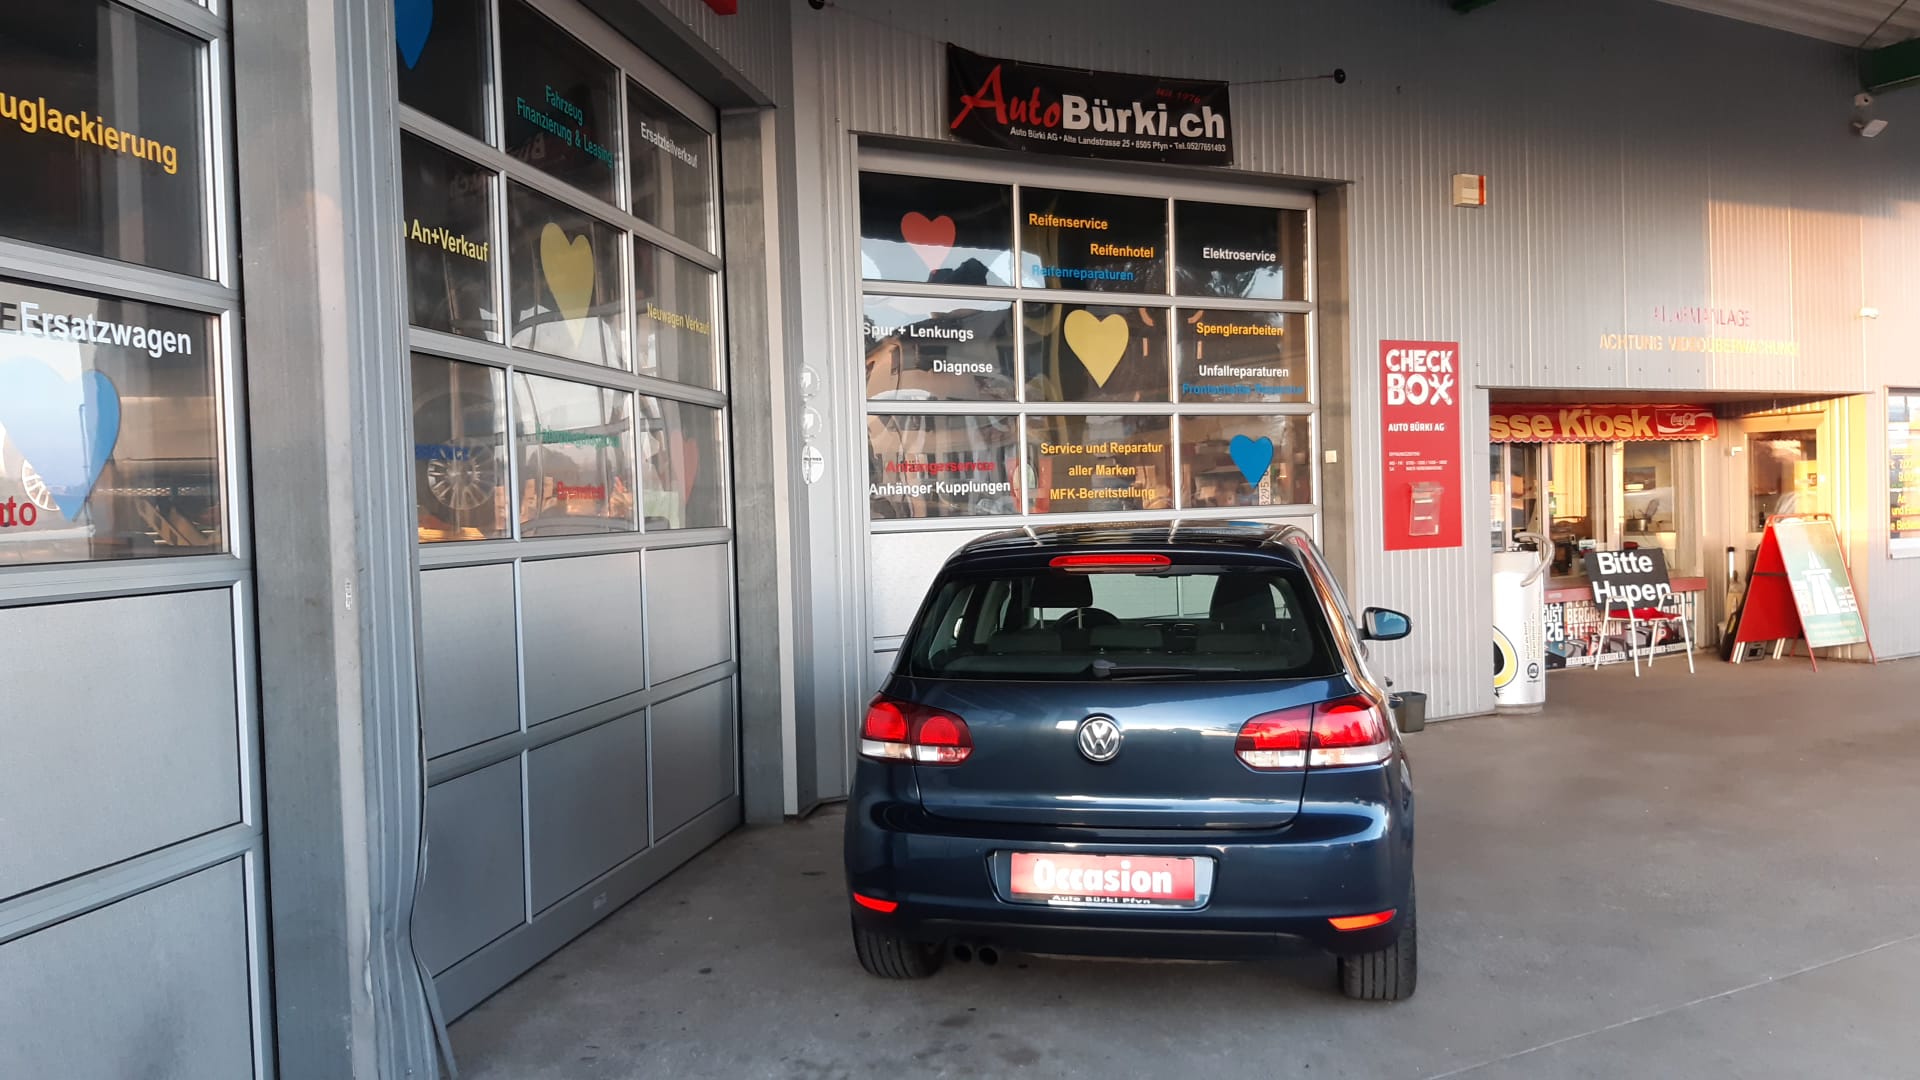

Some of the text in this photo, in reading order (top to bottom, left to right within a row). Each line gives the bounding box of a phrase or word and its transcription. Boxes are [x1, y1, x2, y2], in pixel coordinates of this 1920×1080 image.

[545, 85, 584, 126] Fahrzeug
[516, 96, 573, 146] Finanzierung
[574, 130, 581, 148] &
[583, 134, 615, 169] Leasing
[1010, 126, 1027, 137] Auto
[1028, 129, 1046, 140] Bürki
[1047, 132, 1058, 141] AG
[1078, 136, 1121, 148] Landstrasse
[1122, 139, 1130, 148] 25
[1152, 141, 1168, 151] Pfyn
[640, 121, 698, 169] Ersatzteilverkauf
[1029, 213, 1108, 230] Reifenservice
[411, 218, 489, 262] An+Verkauf
[1090, 243, 1154, 259] Reifenhotel
[1202, 247, 1277, 262] Elektroservice
[1032, 264, 1135, 282] Reifenreparaturen
[647, 302, 684, 329] Neuwagen
[20, 301, 192, 359] Ersatzwagen
[863, 322, 975, 343] Spur + Lenkungs
[1196, 322, 1284, 337] Spenglerarbeiten
[1600, 333, 1663, 351] ACHTUNG
[933, 360, 993, 376] Diagnose
[1385, 349, 1454, 373] CHECK
[1198, 364, 1289, 379] Unfallreparaturen
[1387, 373, 1454, 406] BOX
[1388, 421, 1445, 432] AUTO BÜRKI AG
[1558, 408, 1655, 439] Kiosk
[1041, 442, 1163, 455] Service und Reparatur
[1068, 464, 1136, 476] aller Marken
[869, 481, 1011, 498] Anhänger Kupplungen
[1050, 487, 1155, 500] MFK-Bereitstellung
[1597, 552, 1653, 575] Bitte
[1592, 581, 1672, 607] Hupen
[1033, 859, 1173, 894] Occasion
[1052, 894, 1081, 902] Auto
